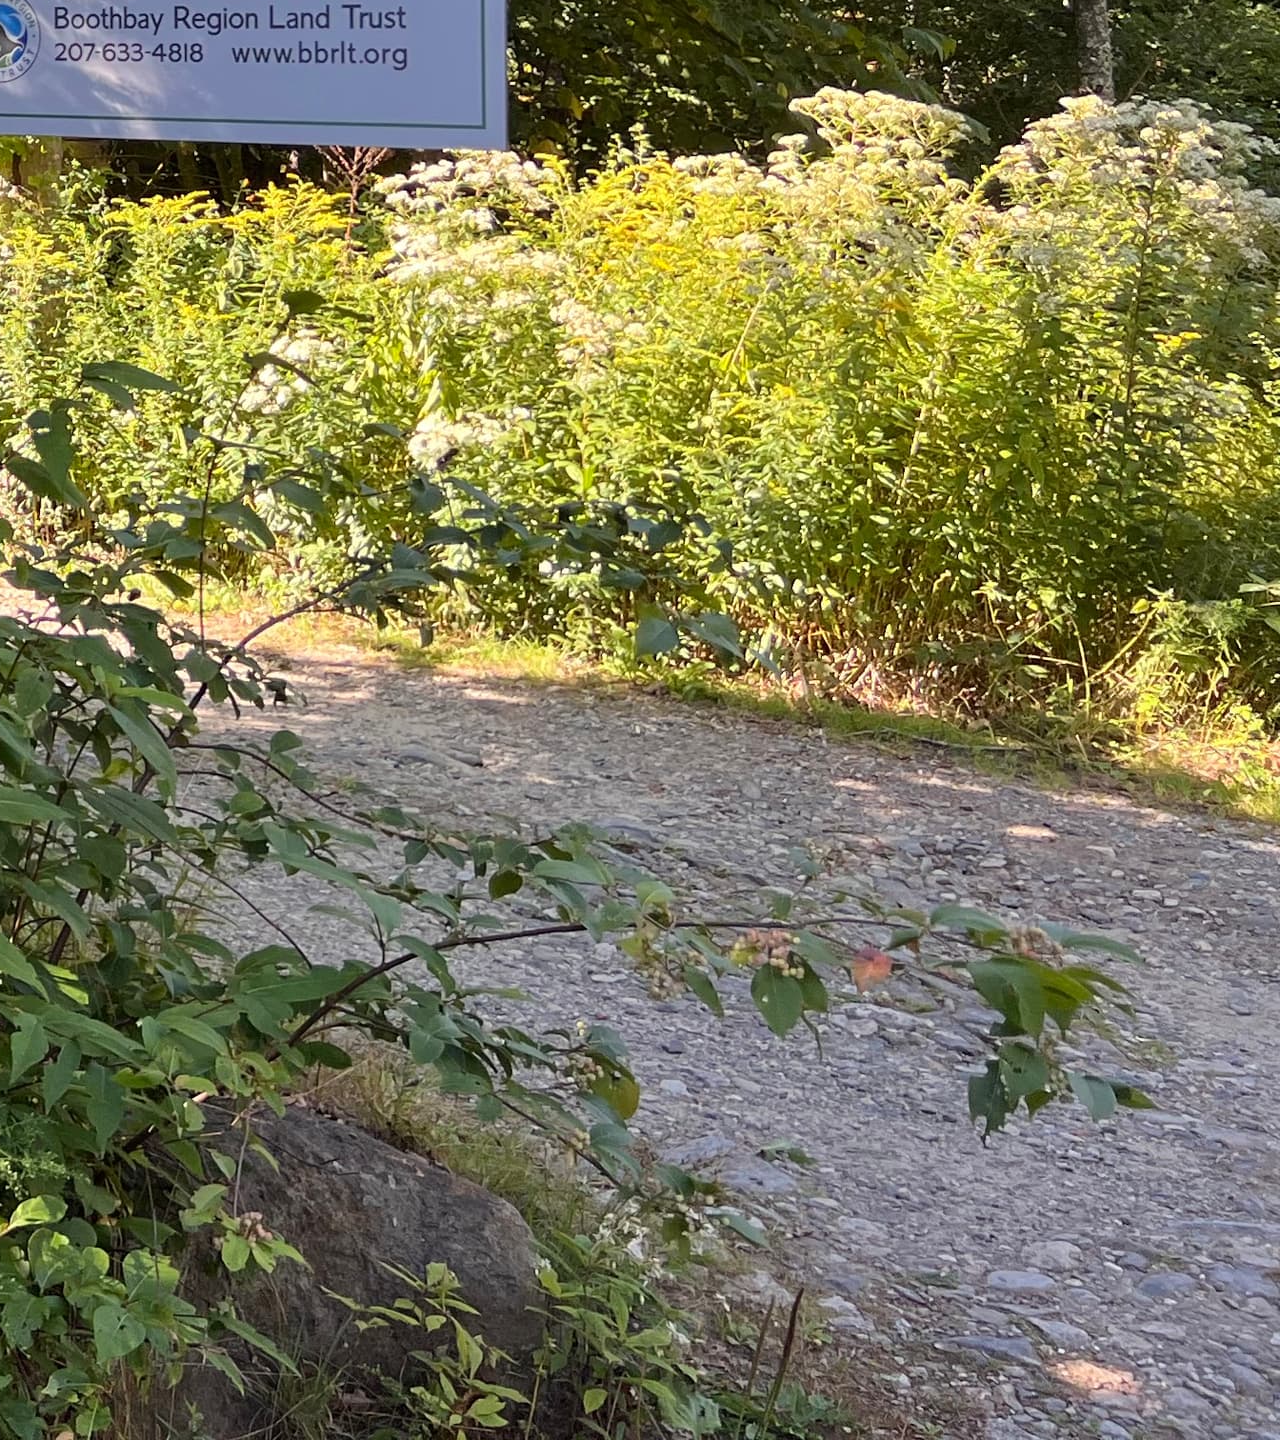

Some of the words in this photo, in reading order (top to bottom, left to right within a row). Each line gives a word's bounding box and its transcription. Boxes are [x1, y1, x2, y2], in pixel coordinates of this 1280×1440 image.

[53, 6, 164, 36] Boothbay
[173, 6, 259, 35] Region
[269, 5, 331, 30] Land
[341, 4, 407, 30] Trust
[0, 48, 35, 79] TRUST
[54, 43, 204, 63] 207-633-4818
[231, 41, 408, 71] www.bbrlt.org
